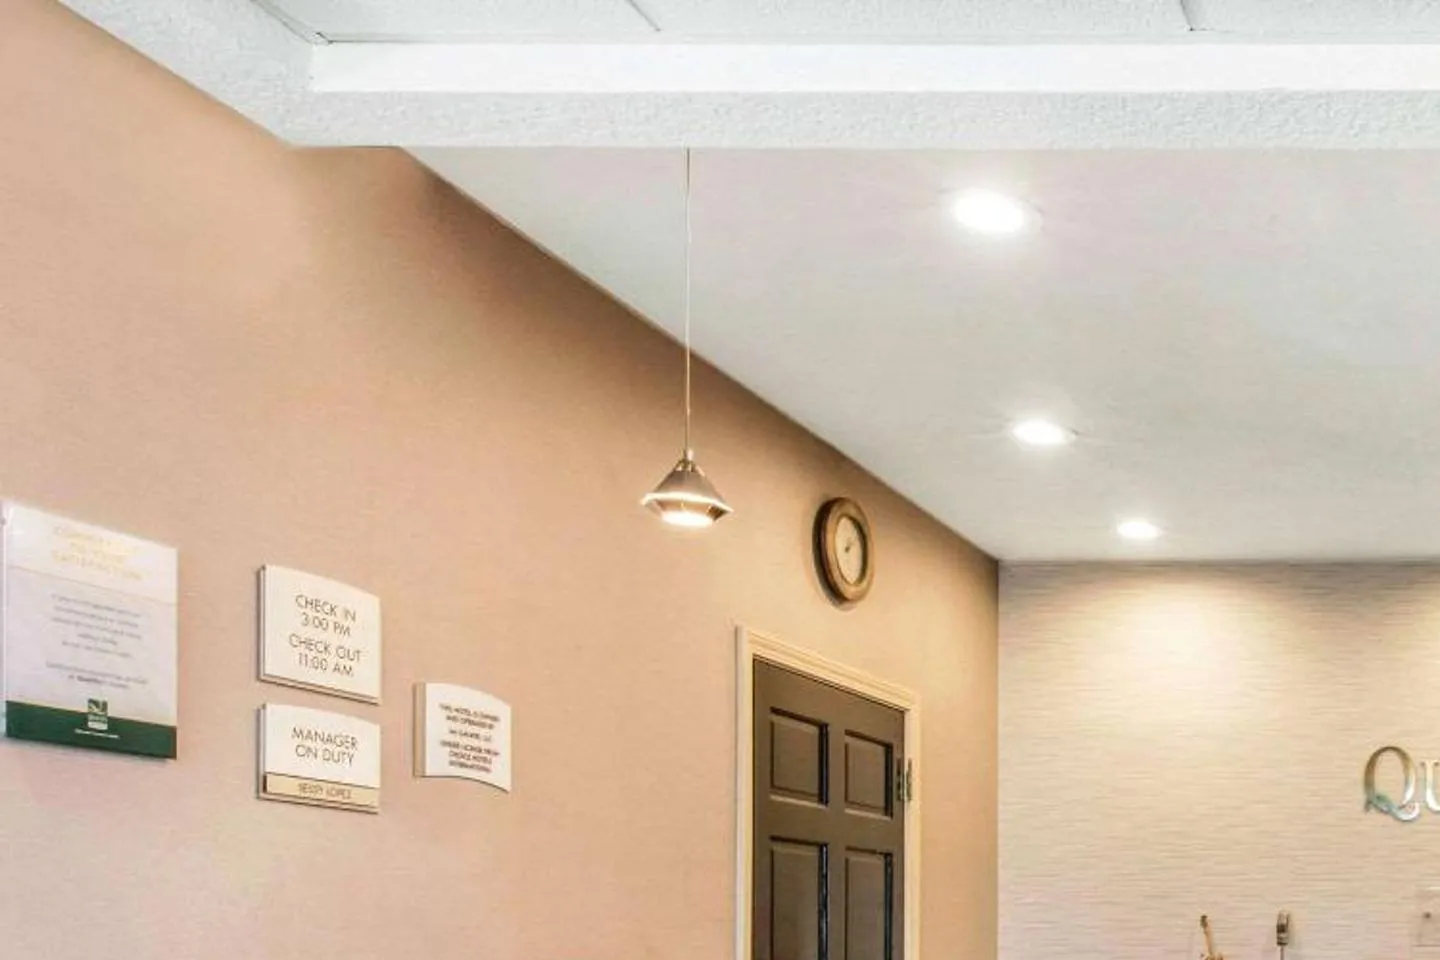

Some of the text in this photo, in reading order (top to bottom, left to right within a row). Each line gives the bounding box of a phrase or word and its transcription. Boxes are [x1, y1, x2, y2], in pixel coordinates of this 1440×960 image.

[295, 594, 356, 621] CHECK IN
[300, 612, 351, 636] 3:00 PM
[288, 633, 361, 661] CHECK OUT
[298, 652, 354, 677] 11:00 AM
[291, 726, 358, 751] MANAGER
[295, 744, 355, 766] ON DUTY
